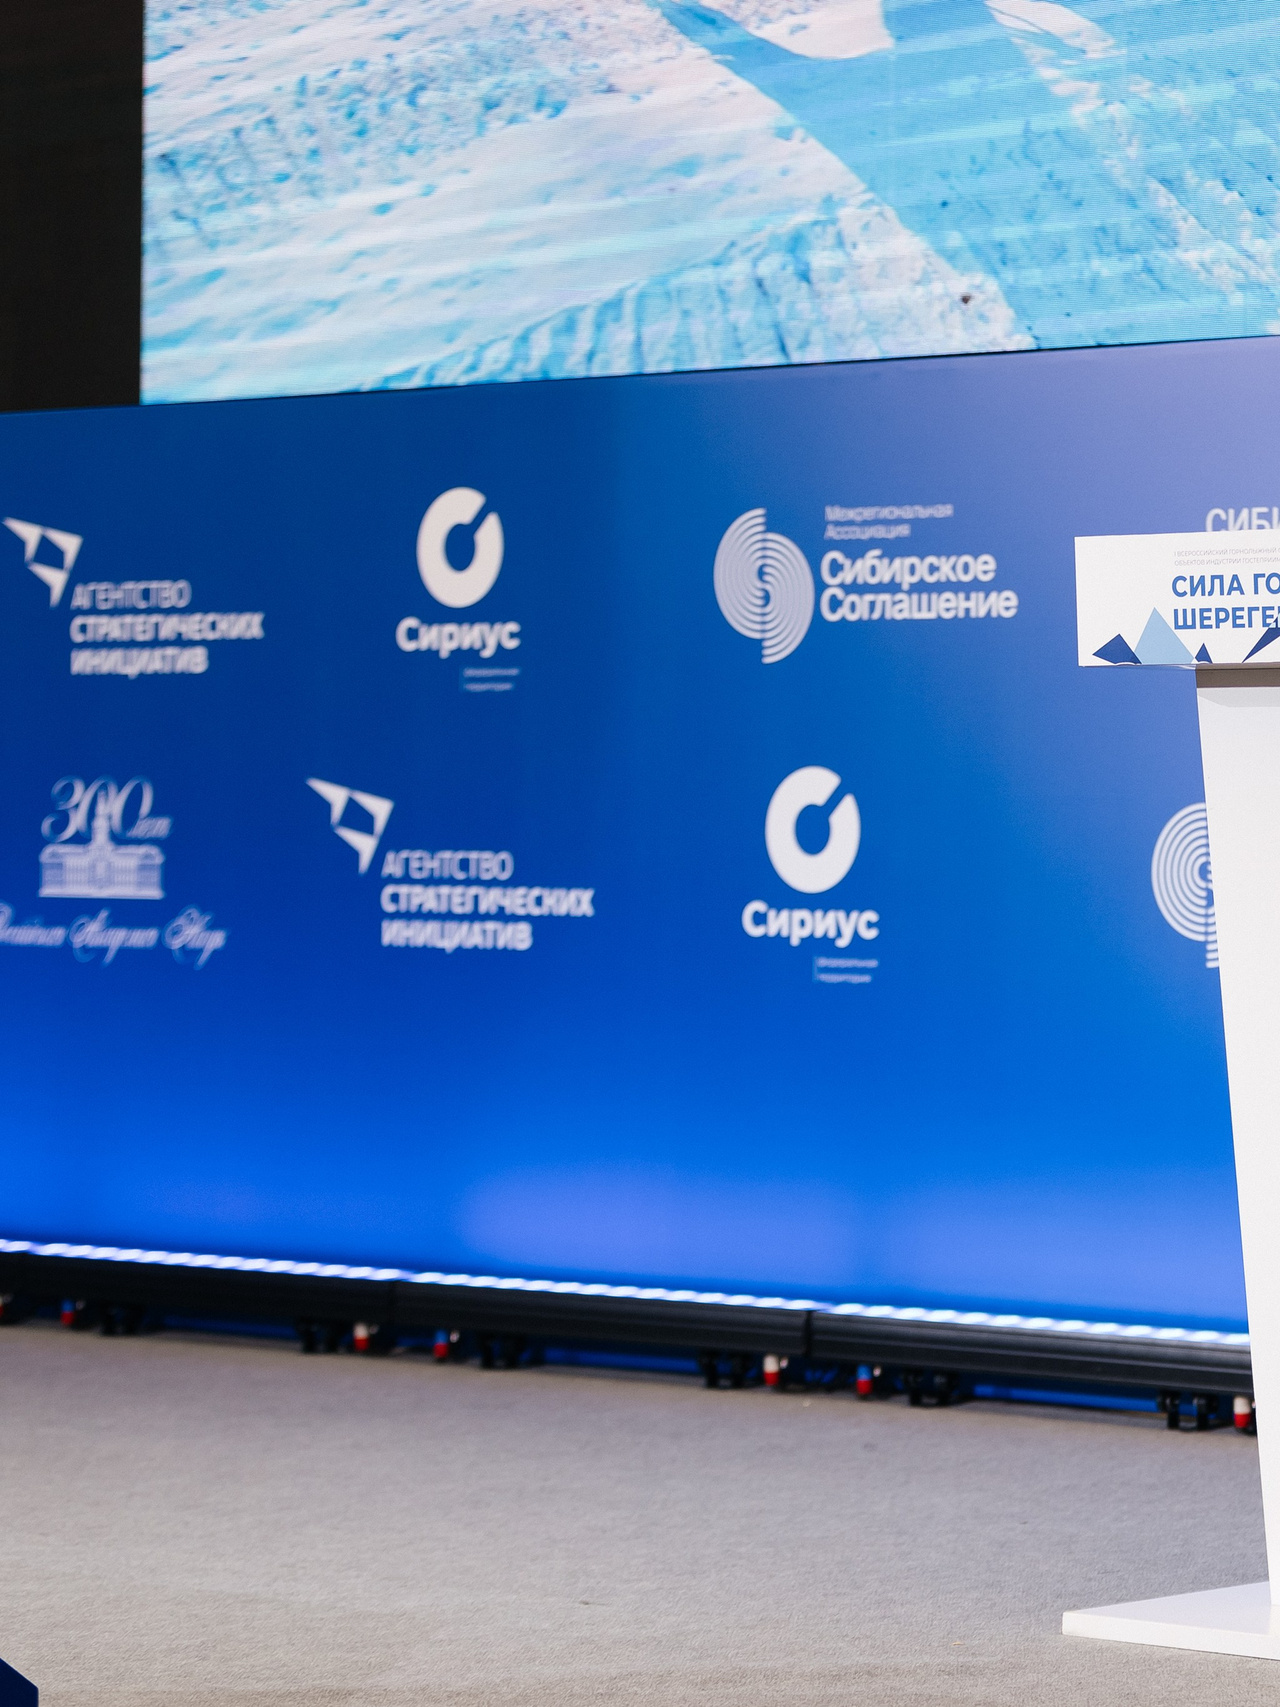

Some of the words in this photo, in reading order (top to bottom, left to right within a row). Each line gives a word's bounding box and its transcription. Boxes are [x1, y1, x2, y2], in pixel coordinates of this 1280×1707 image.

[1177, 549, 1228, 557] ВСЕРОССИЙСКИЙ
[1229, 547, 1276, 555] ГОРНОЛЫЖНЫЙ
[1206, 557, 1241, 565] ИНДУСТРИИ
[820, 548, 998, 591] Сибирское
[1172, 574, 1245, 597] СИЛА
[70, 579, 192, 610] АГЕНТСТВО
[820, 586, 1019, 622] Соглашение
[69, 611, 265, 643] СТРАТЕГИЧЕСКИХ
[396, 616, 521, 659] Сириус
[70, 645, 209, 680] ИНИЦИАТИВ
[381, 849, 515, 881] АГЕНТСТВО
[380, 883, 595, 917] СТРАТЕГИЧЕСКИХ
[381, 918, 533, 954] ИНИЦИАТИВ
[741, 900, 880, 948] Сириус
